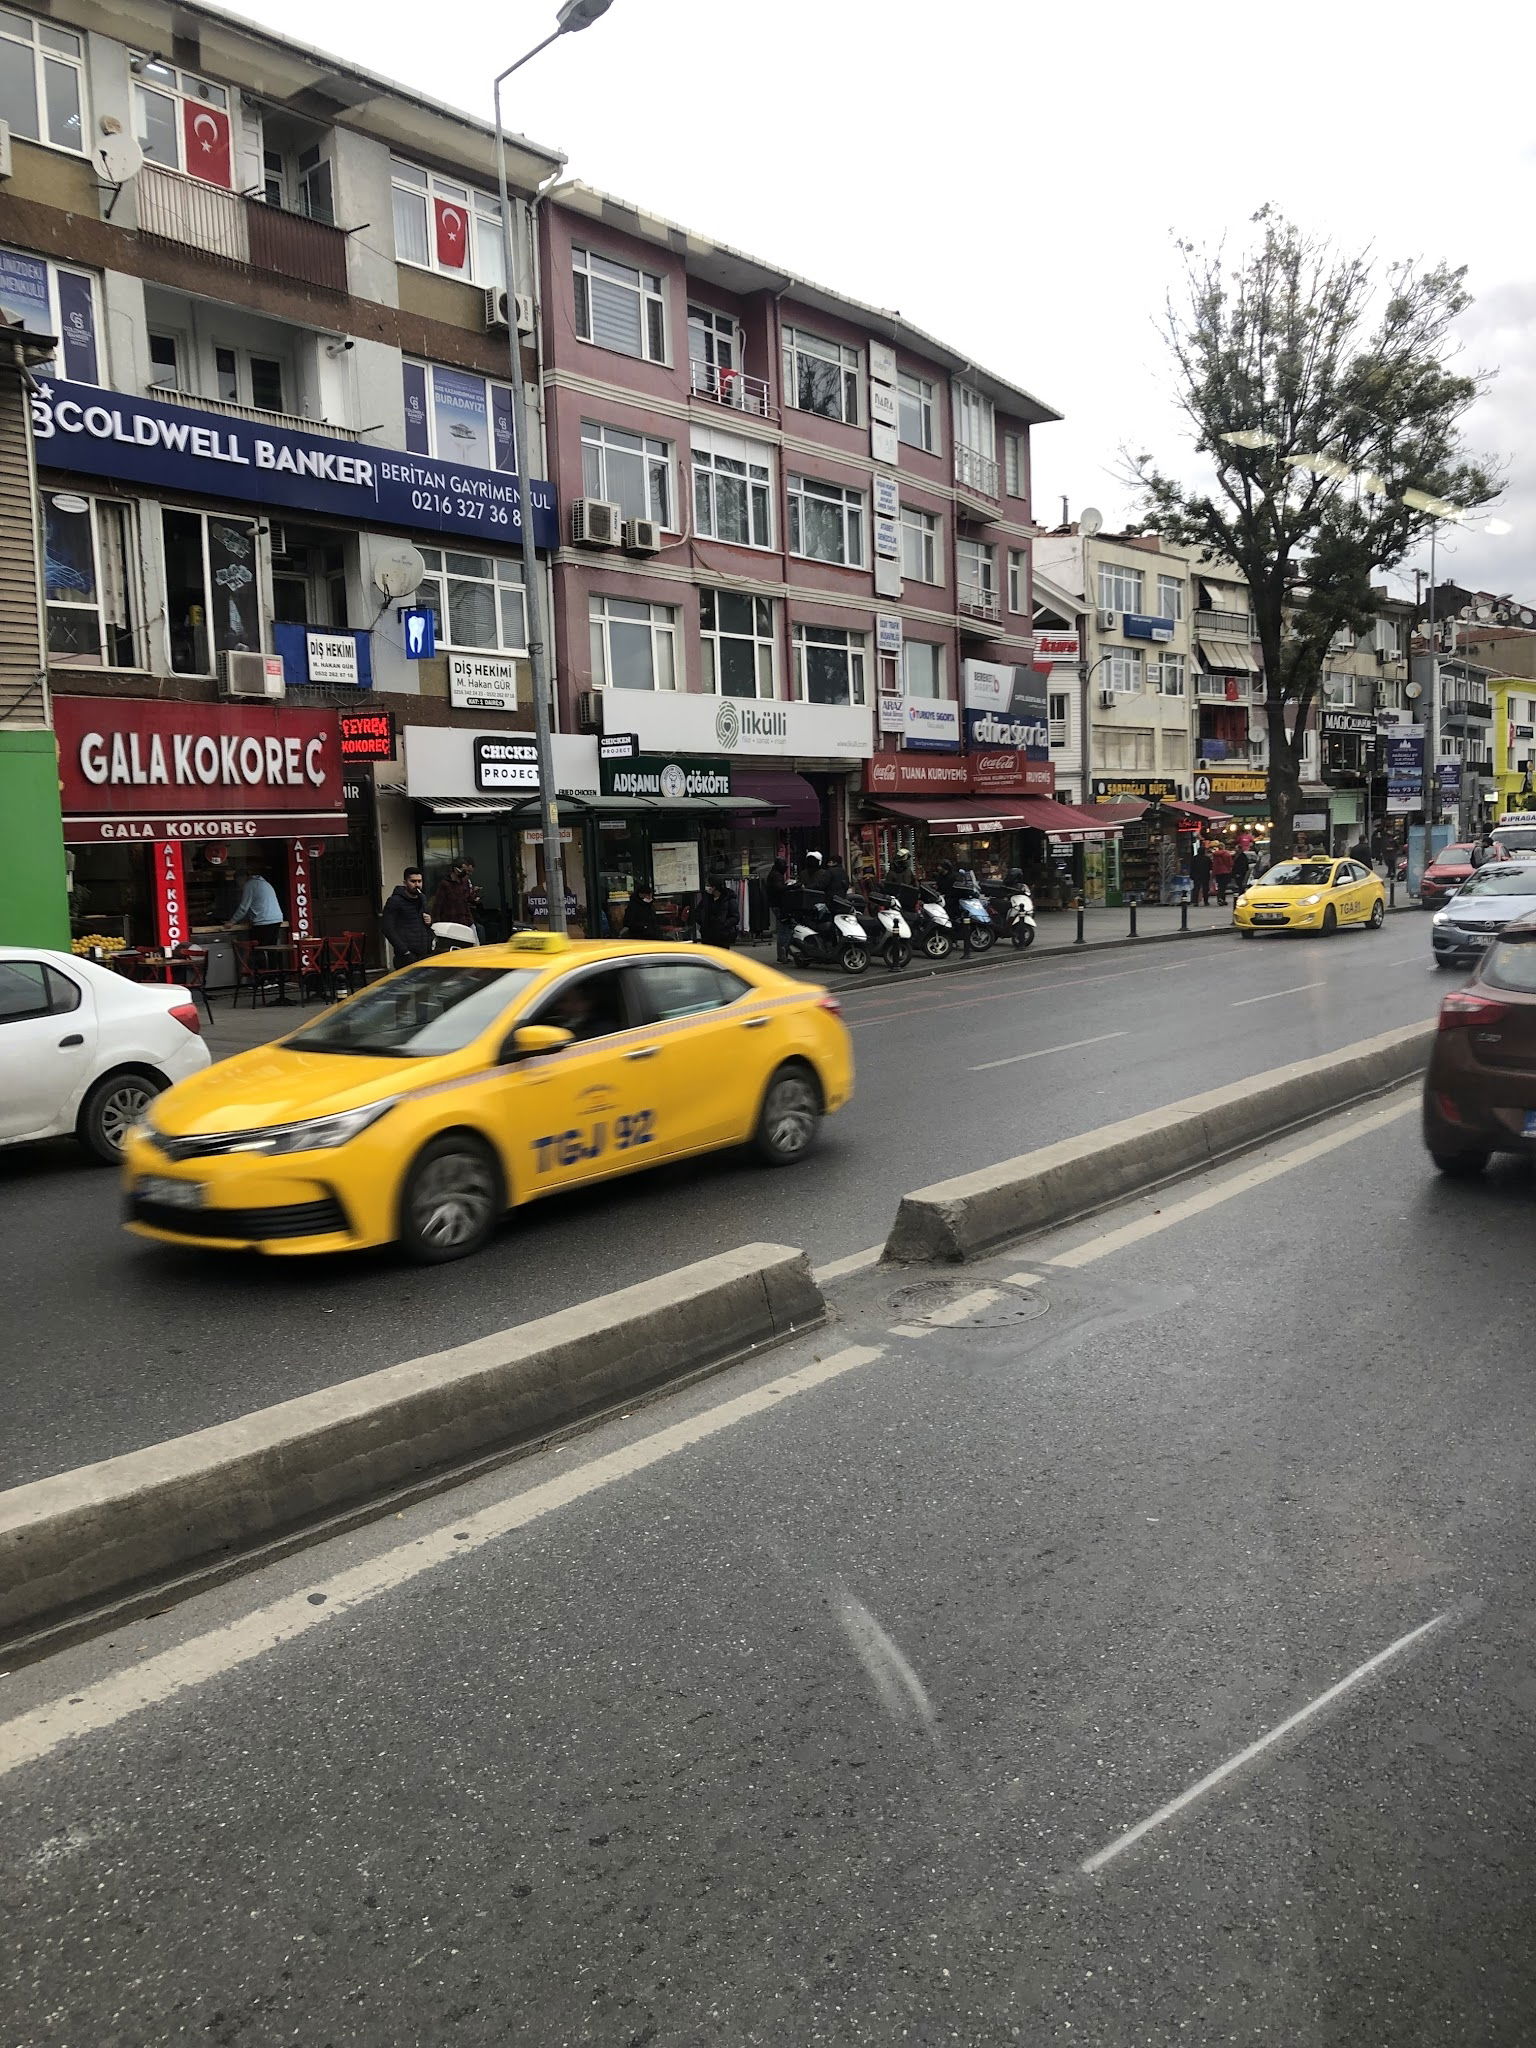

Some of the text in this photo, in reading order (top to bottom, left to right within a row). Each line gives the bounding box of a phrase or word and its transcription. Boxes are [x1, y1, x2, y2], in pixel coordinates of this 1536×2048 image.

[54, 400, 250, 466] COLDWELL
[254, 439, 374, 487] BANKER
[381, 462, 446, 489] BERİTAN
[412, 490, 452, 514] 0216
[457, 499, 485, 520] 327
[490, 504, 509, 524] 36
[310, 639, 355, 659] DİŞ HEKİMİ
[454, 660, 512, 678] DİŞ HEKİMİ
[468, 679, 493, 689] Hakan
[494, 680, 511, 690] GÜR
[882, 701, 903, 711] ARAZ
[741, 710, 787, 736] likülli
[1325, 714, 1352, 730] MAGIC
[341, 739, 389, 754] KOKOREÇ
[481, 745, 539, 760] CHICKEN
[80, 732, 327, 788] GALA KOKOREÇ
[484, 768, 539, 779] PROJECT
[900, 766, 927, 780] TUANA
[927, 766, 968, 783] KURUYEMİŞ
[613, 773, 660, 797] ADIŞANLI
[686, 770, 730, 797] ÇİĞKÖFTE
[101, 820, 257, 838] GALA KOKOREÇ
[1339, 902, 1354, 914] TGA
